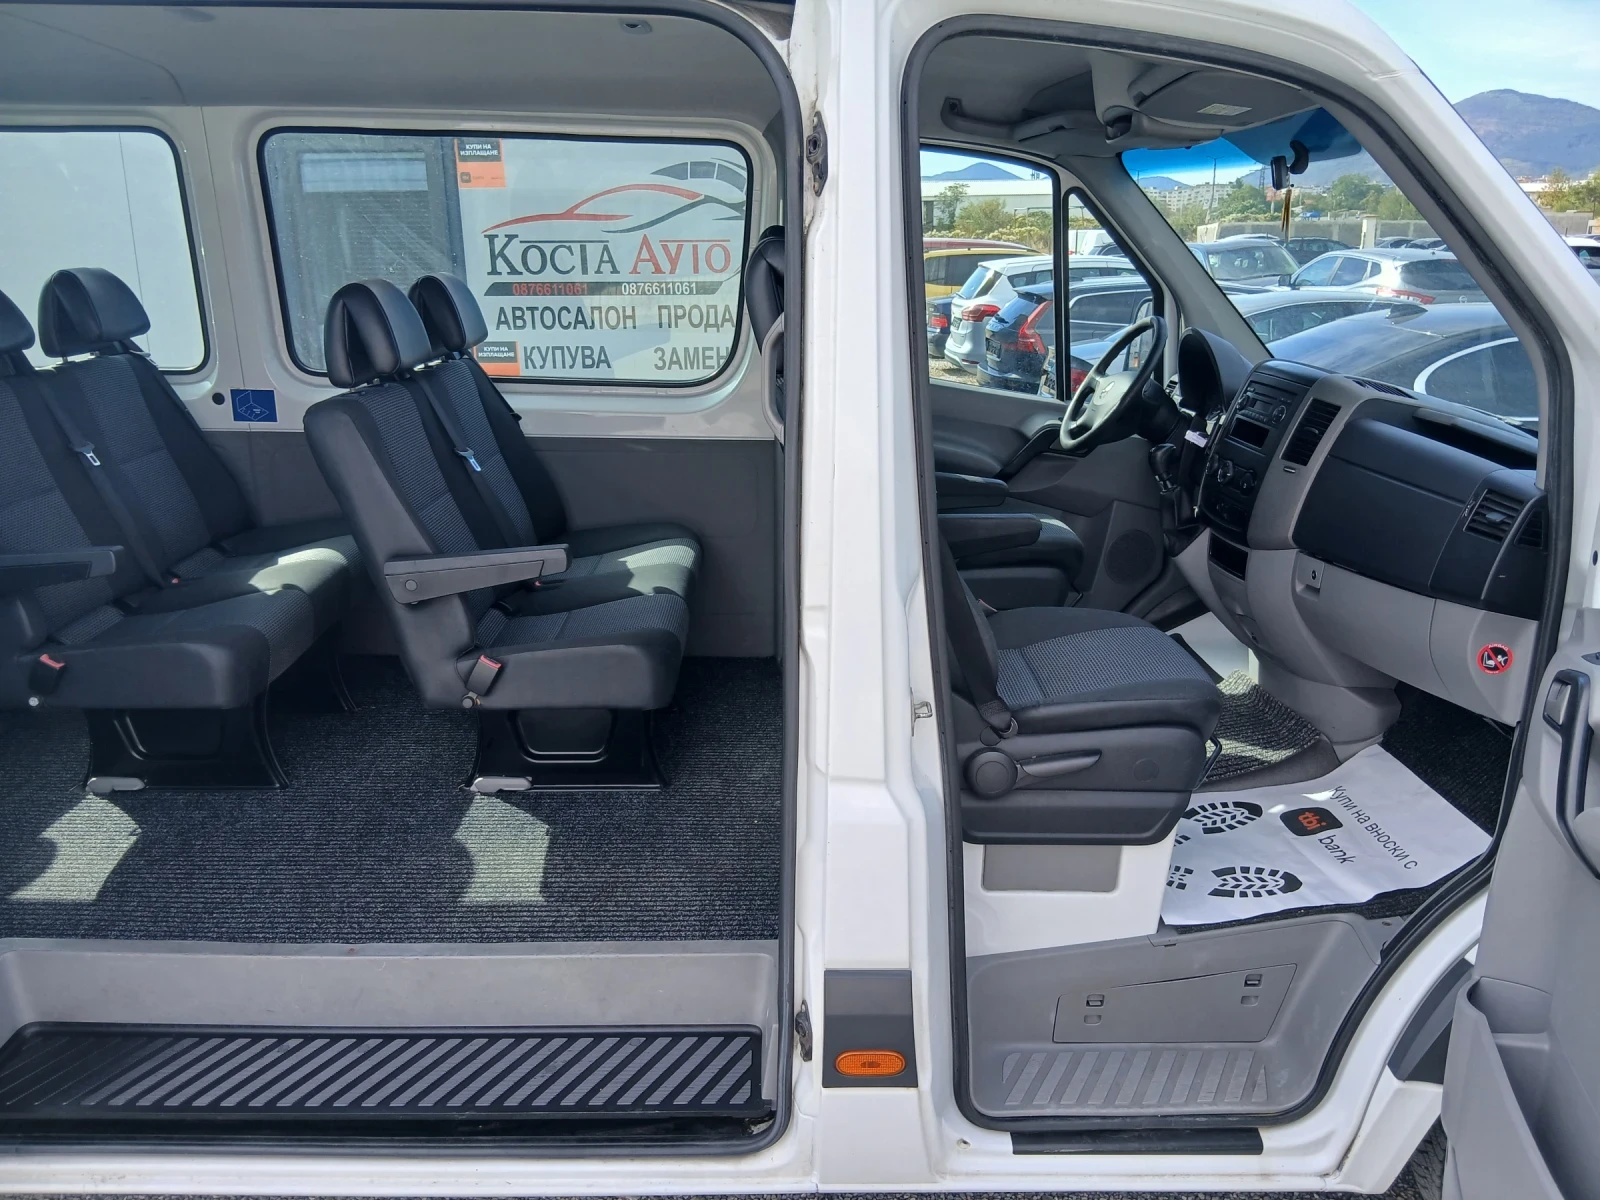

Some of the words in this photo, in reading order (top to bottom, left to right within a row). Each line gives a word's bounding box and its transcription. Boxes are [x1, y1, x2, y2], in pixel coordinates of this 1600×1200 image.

[512, 283, 589, 295] 0876611061
[621, 282, 697, 295] 0876611061
[495, 306, 637, 331] АВТОСАЛОН
[523, 346, 612, 370] КУПУВА
[1298, 811, 1327, 830] tbi
[1350, 809, 1371, 825] на
[1318, 834, 1356, 864] bank
